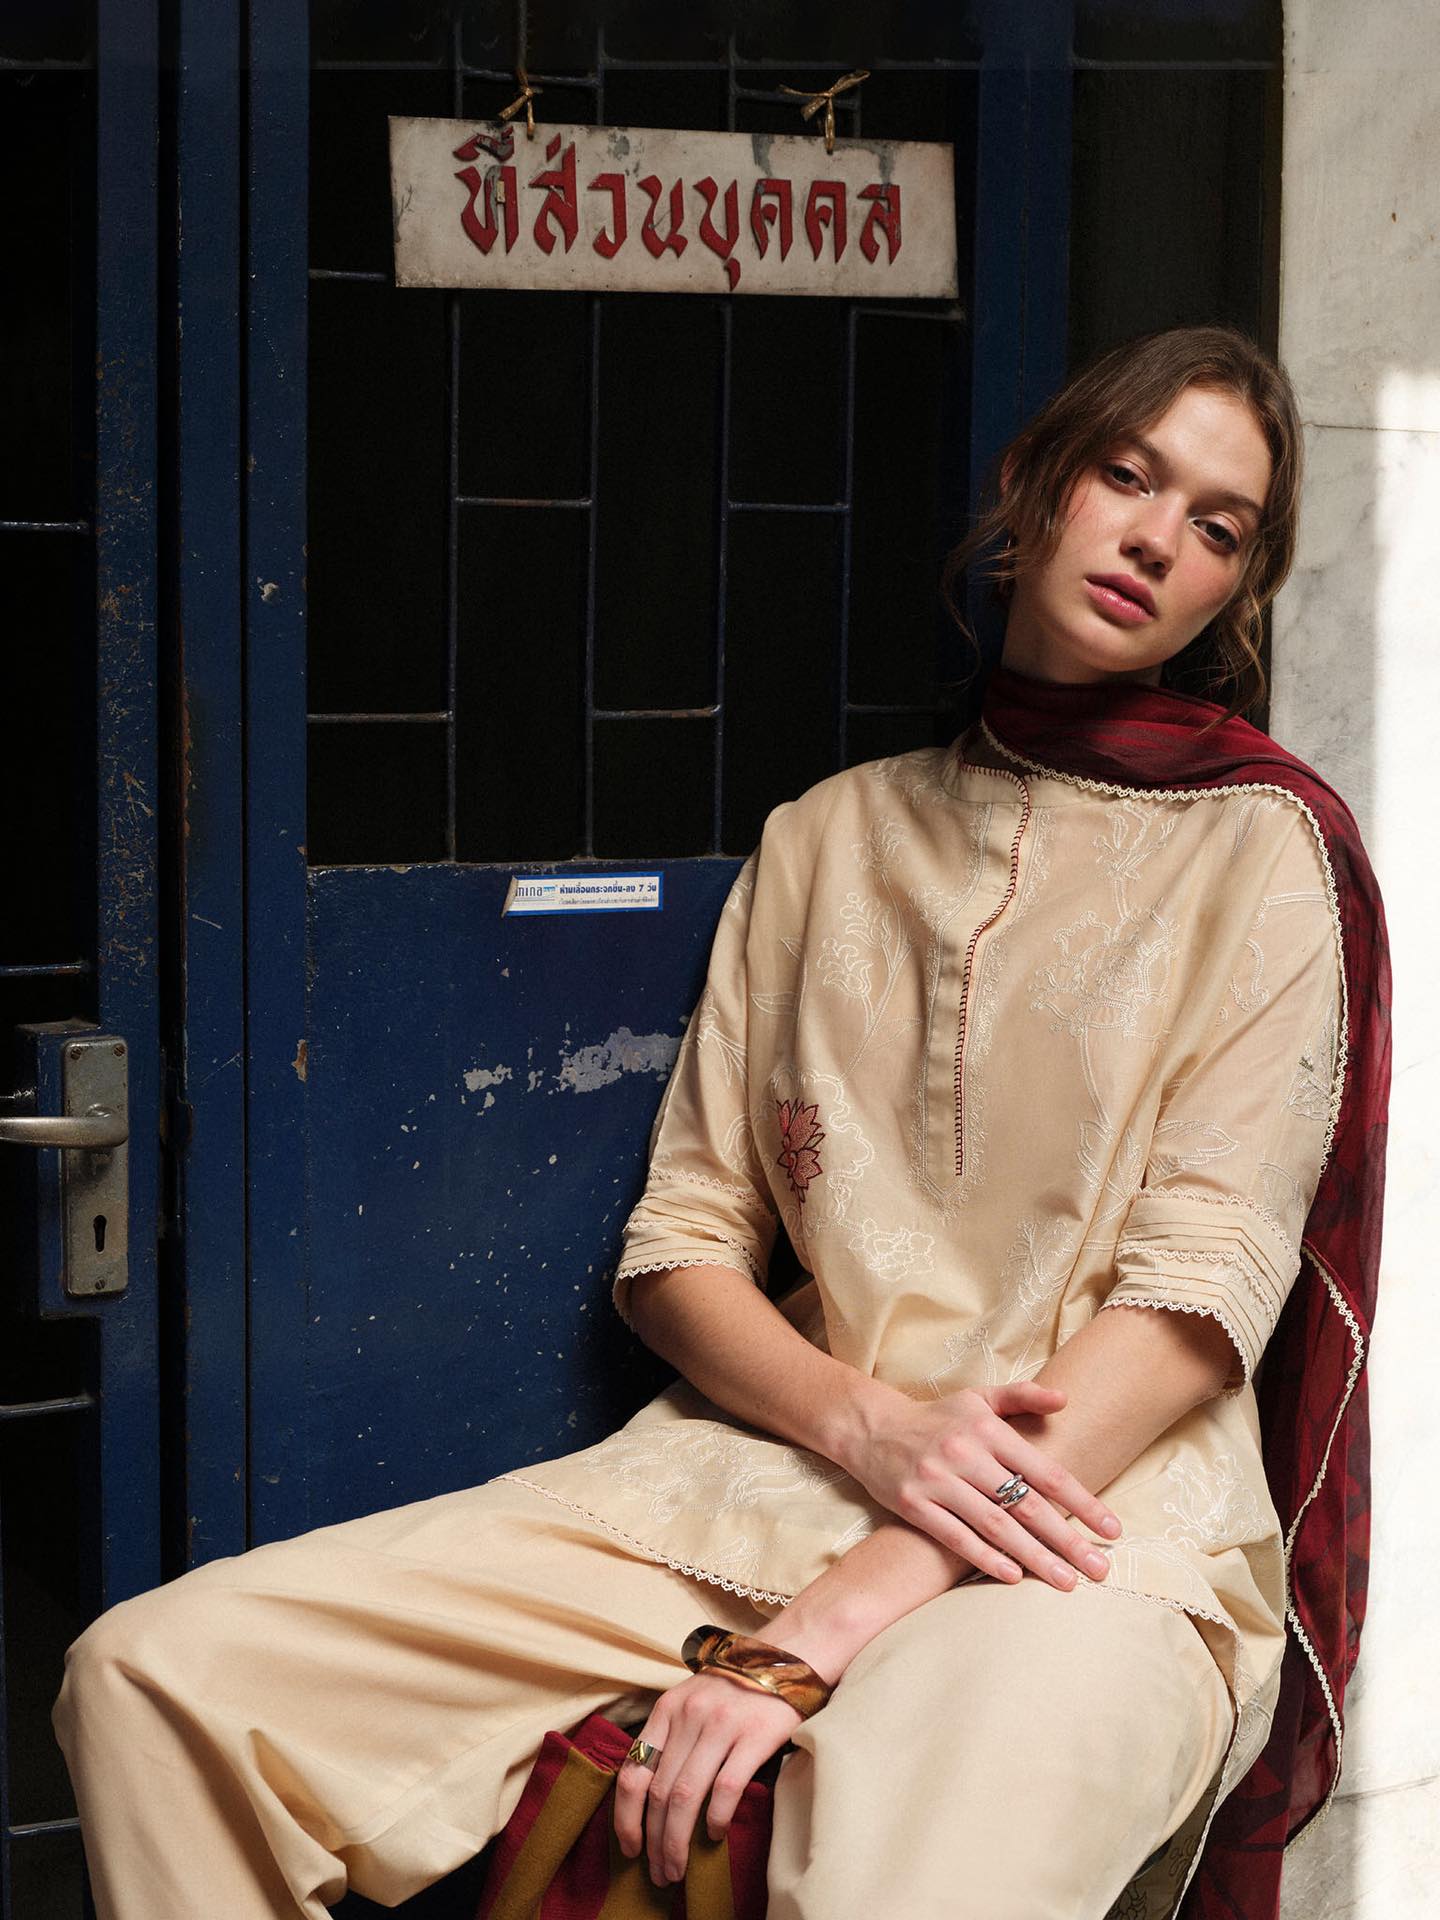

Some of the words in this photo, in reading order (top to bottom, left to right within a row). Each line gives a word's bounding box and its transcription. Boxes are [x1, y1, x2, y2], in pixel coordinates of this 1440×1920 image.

[453, 126, 902, 291] ที่ส่วนบุคคล
[639, 884, 645, 892] 7
